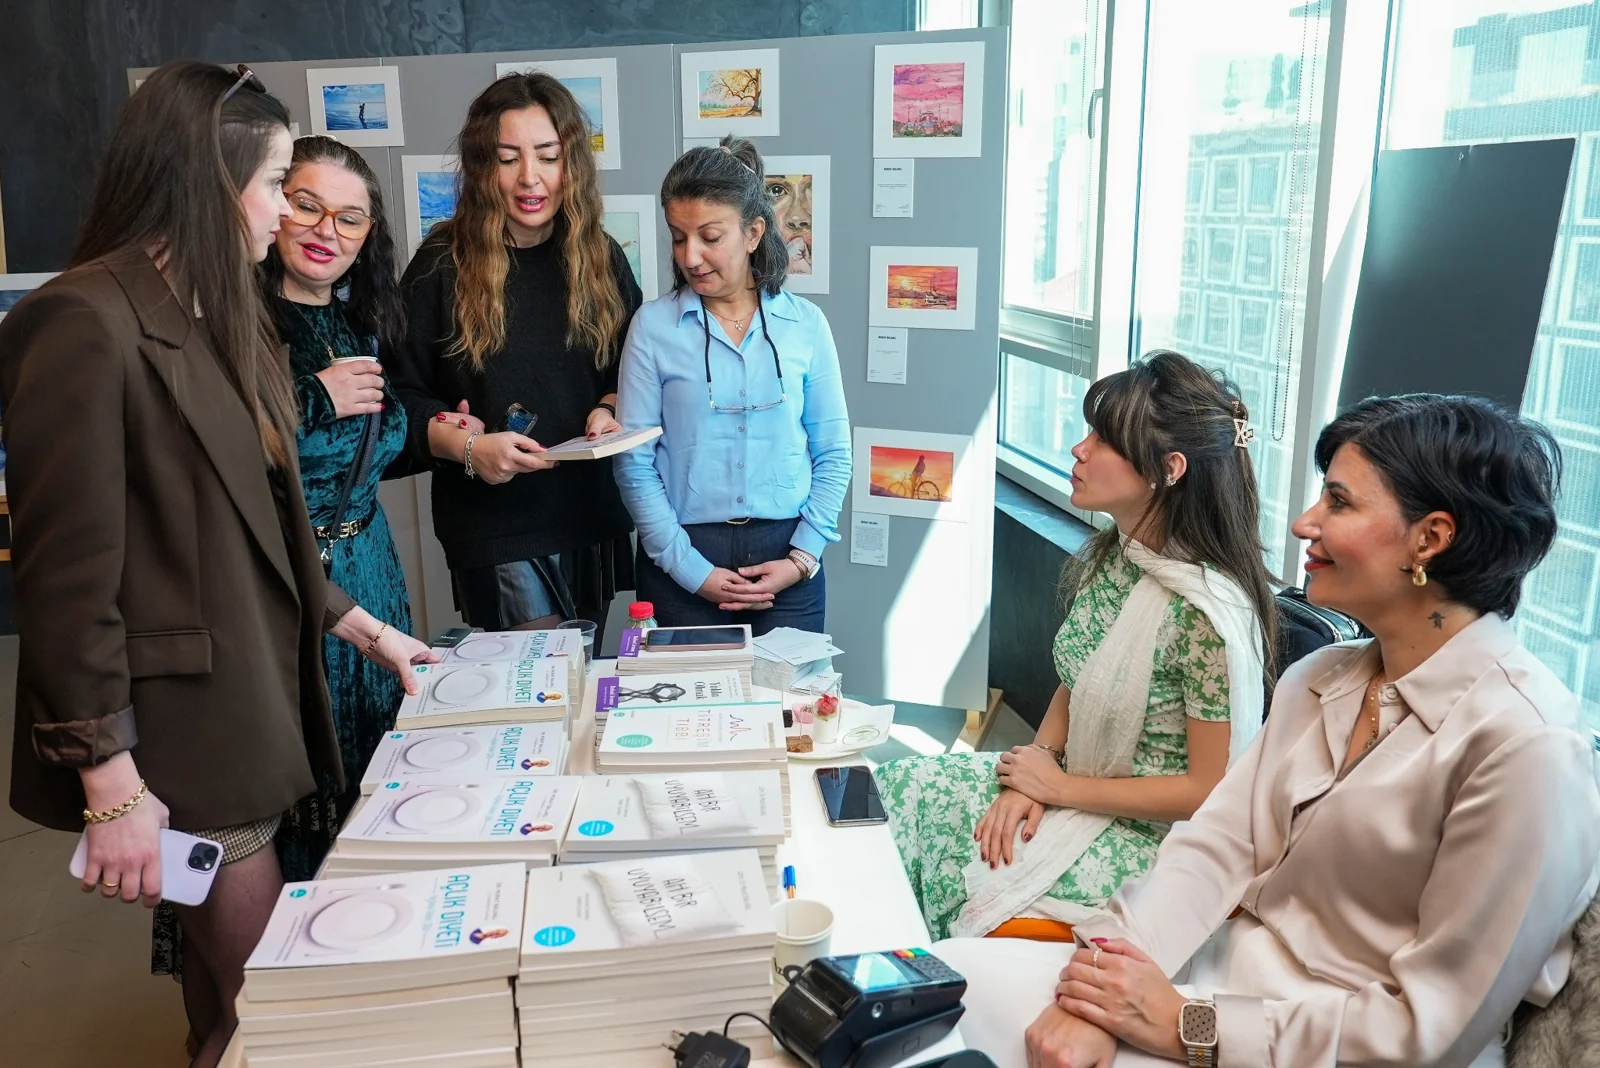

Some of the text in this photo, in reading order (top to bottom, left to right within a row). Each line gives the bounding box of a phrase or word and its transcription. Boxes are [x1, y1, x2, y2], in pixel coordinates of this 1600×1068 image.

[514, 660, 534, 679] AÇLIK
[496, 726, 523, 770] AÇLIK DİYETİ
[506, 781, 534, 806] AÇLIK
[694, 789, 716, 802] AH
[490, 808, 522, 835] DİYETİ
[663, 878, 688, 894] AH
[434, 874, 470, 948] AÇLIK DİYETİ
